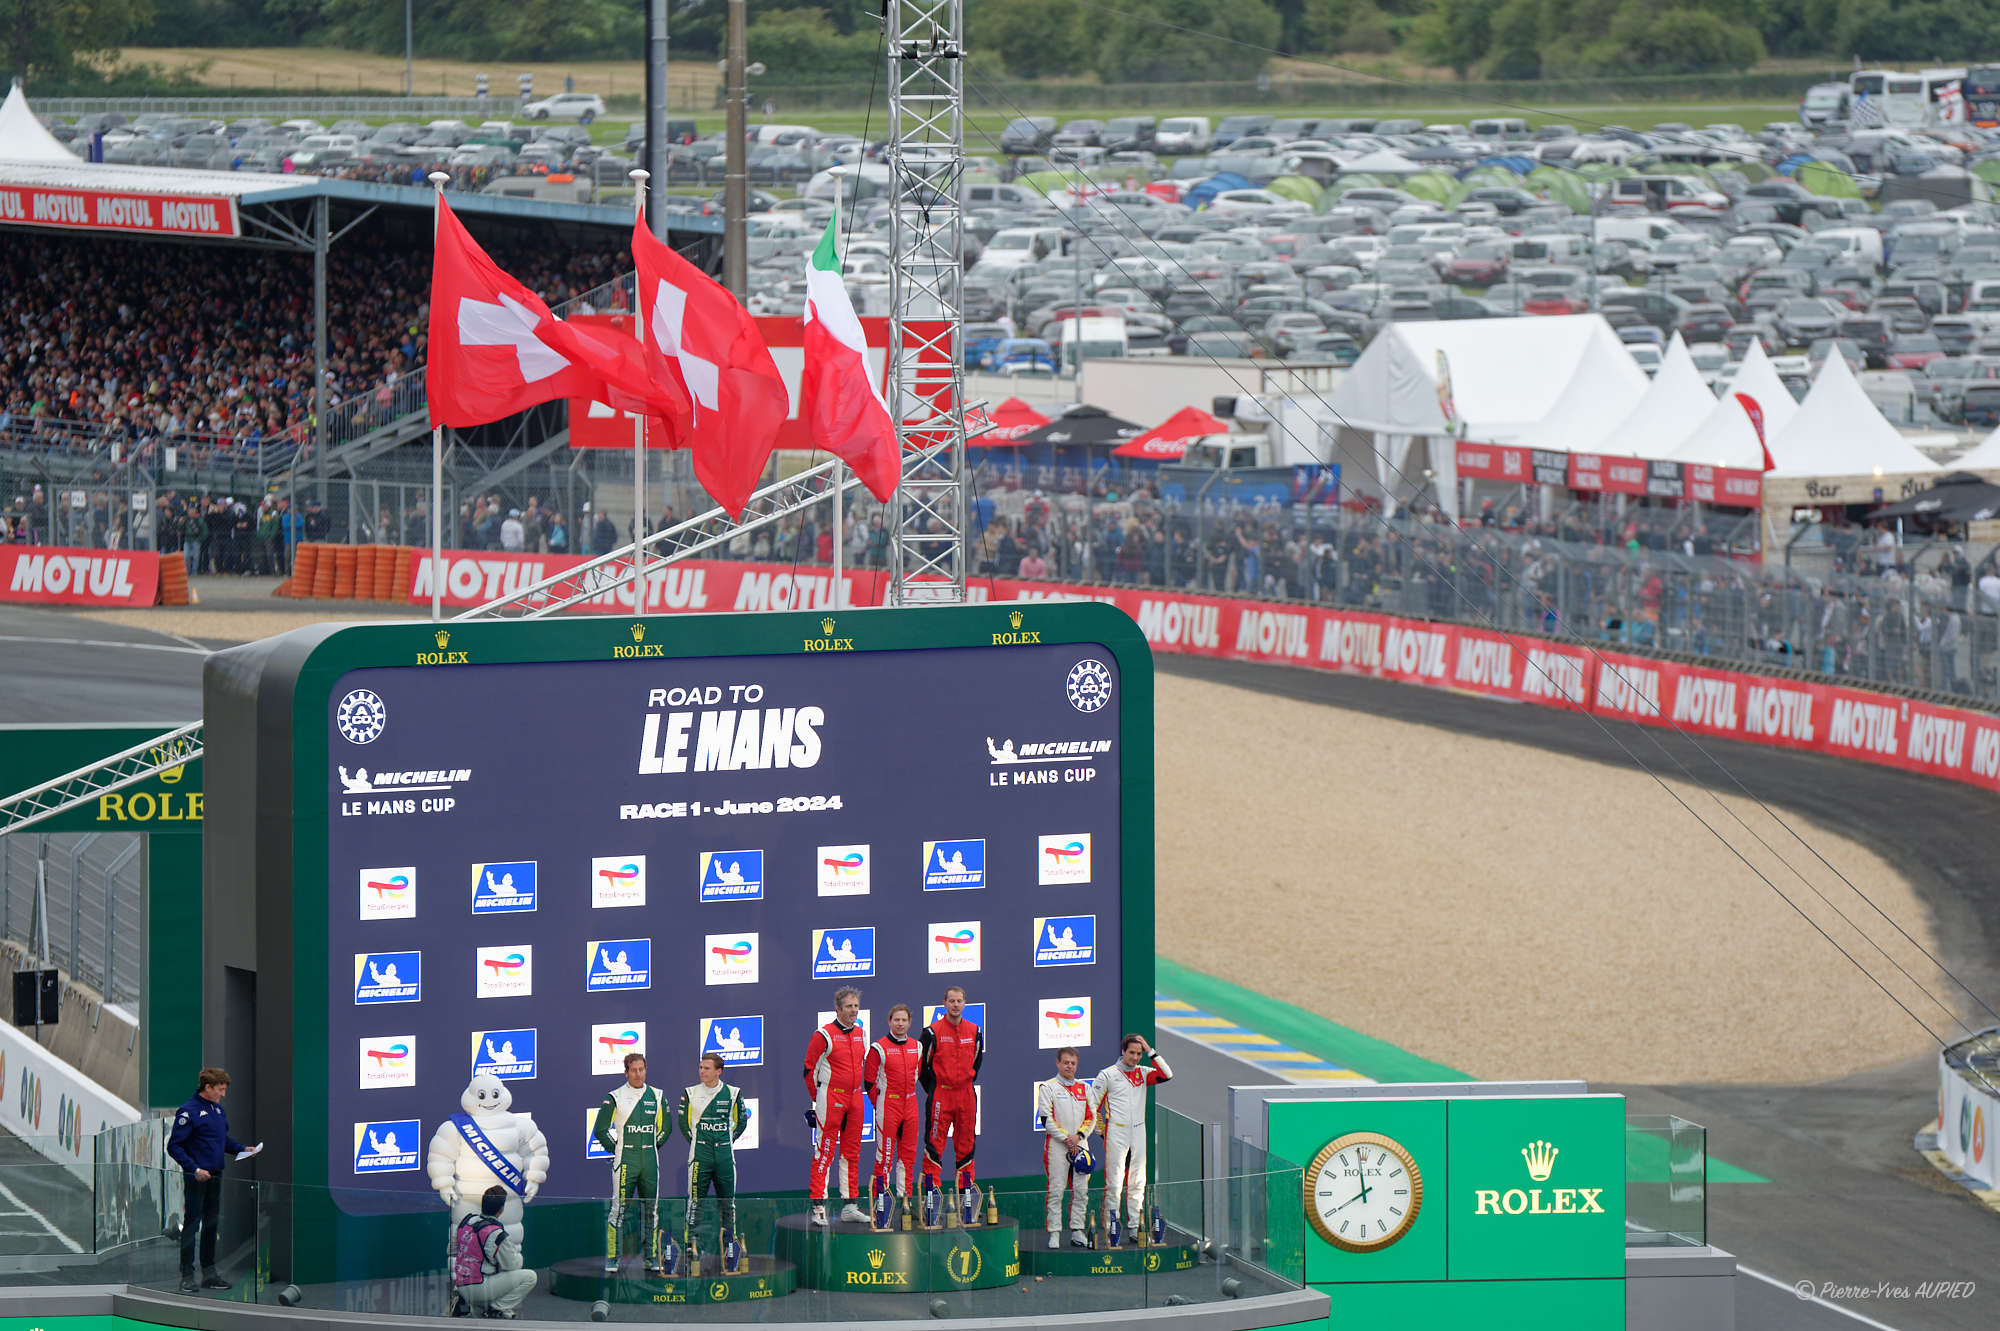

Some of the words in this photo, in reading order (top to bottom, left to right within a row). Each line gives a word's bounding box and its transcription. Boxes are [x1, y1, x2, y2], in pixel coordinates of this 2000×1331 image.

[33, 193, 88, 223] MOTUL
[97, 197, 152, 227] MOTUL
[162, 201, 219, 231] MOTUL
[10, 554, 134, 597] MOTUL
[804, 638, 854, 651] ROLEX
[991, 631, 1041, 645] ROLEX
[413, 557, 550, 602] MOTUL
[582, 566, 708, 609] MOTUL
[733, 571, 856, 610] MOTUL
[1137, 600, 1220, 648] MOTUL
[1236, 609, 1309, 657] MOTUL
[1320, 619, 1382, 667] MOTUL
[1383, 626, 1447, 677] MOTUL
[1455, 636, 1512, 688] MOTUL
[1522, 649, 1585, 704] MOTUL
[1596, 662, 1661, 717] MOTUL
[1673, 674, 1738, 729] MOTUL
[1745, 685, 1814, 741] MOTUL
[1829, 698, 1898, 754] MOTUL
[416, 651, 469, 665] ROLEX
[612, 644, 664, 658] ROLEX
[648, 687, 722, 707] ROAD
[729, 684, 764, 704] TO
[638, 712, 694, 775] LE
[693, 706, 825, 772] MANS
[1020, 740, 1112, 756] MICHELIN
[373, 769, 472, 785] MICHELIN
[990, 772, 1008, 786] LE
[1013, 769, 1059, 785] MANS
[1064, 768, 1096, 783] CUP
[96, 792, 203, 821] ROLE
[342, 802, 362, 816] LE
[367, 799, 416, 815] MANS
[421, 797, 455, 813] CUP
[620, 802, 687, 820] RACE
[690, 801, 701, 817] 1
[713, 800, 774, 816] June
[776, 795, 843, 813] 2024
[926, 874, 982, 885] MICHELIN
[703, 884, 760, 896] MICHELIN
[475, 895, 533, 909] MICHELIN
[1036, 950, 1092, 961] MICHELIN
[815, 962, 871, 974] MICHELIN
[590, 973, 647, 986] MICHELIN
[358, 986, 417, 999] MICHELIN
[717, 1051, 760, 1061] CHELIN
[700, 1122, 728, 1132] TRACE3
[358, 1154, 416, 1167] MICHELIN
[462, 1123, 521, 1187] MICHELIN
[1344, 1168, 1382, 1178] ROLEX
[1474, 1187, 1605, 1216] ROLEX
[960, 1251, 970, 1275] 1
[1091, 1266, 1123, 1274] ROLEX
[846, 1271, 908, 1286] ROLEX
[715, 1283, 725, 1298] 2
[749, 1289, 773, 1298] ROLEX
[653, 1295, 686, 1303] ROLEX
